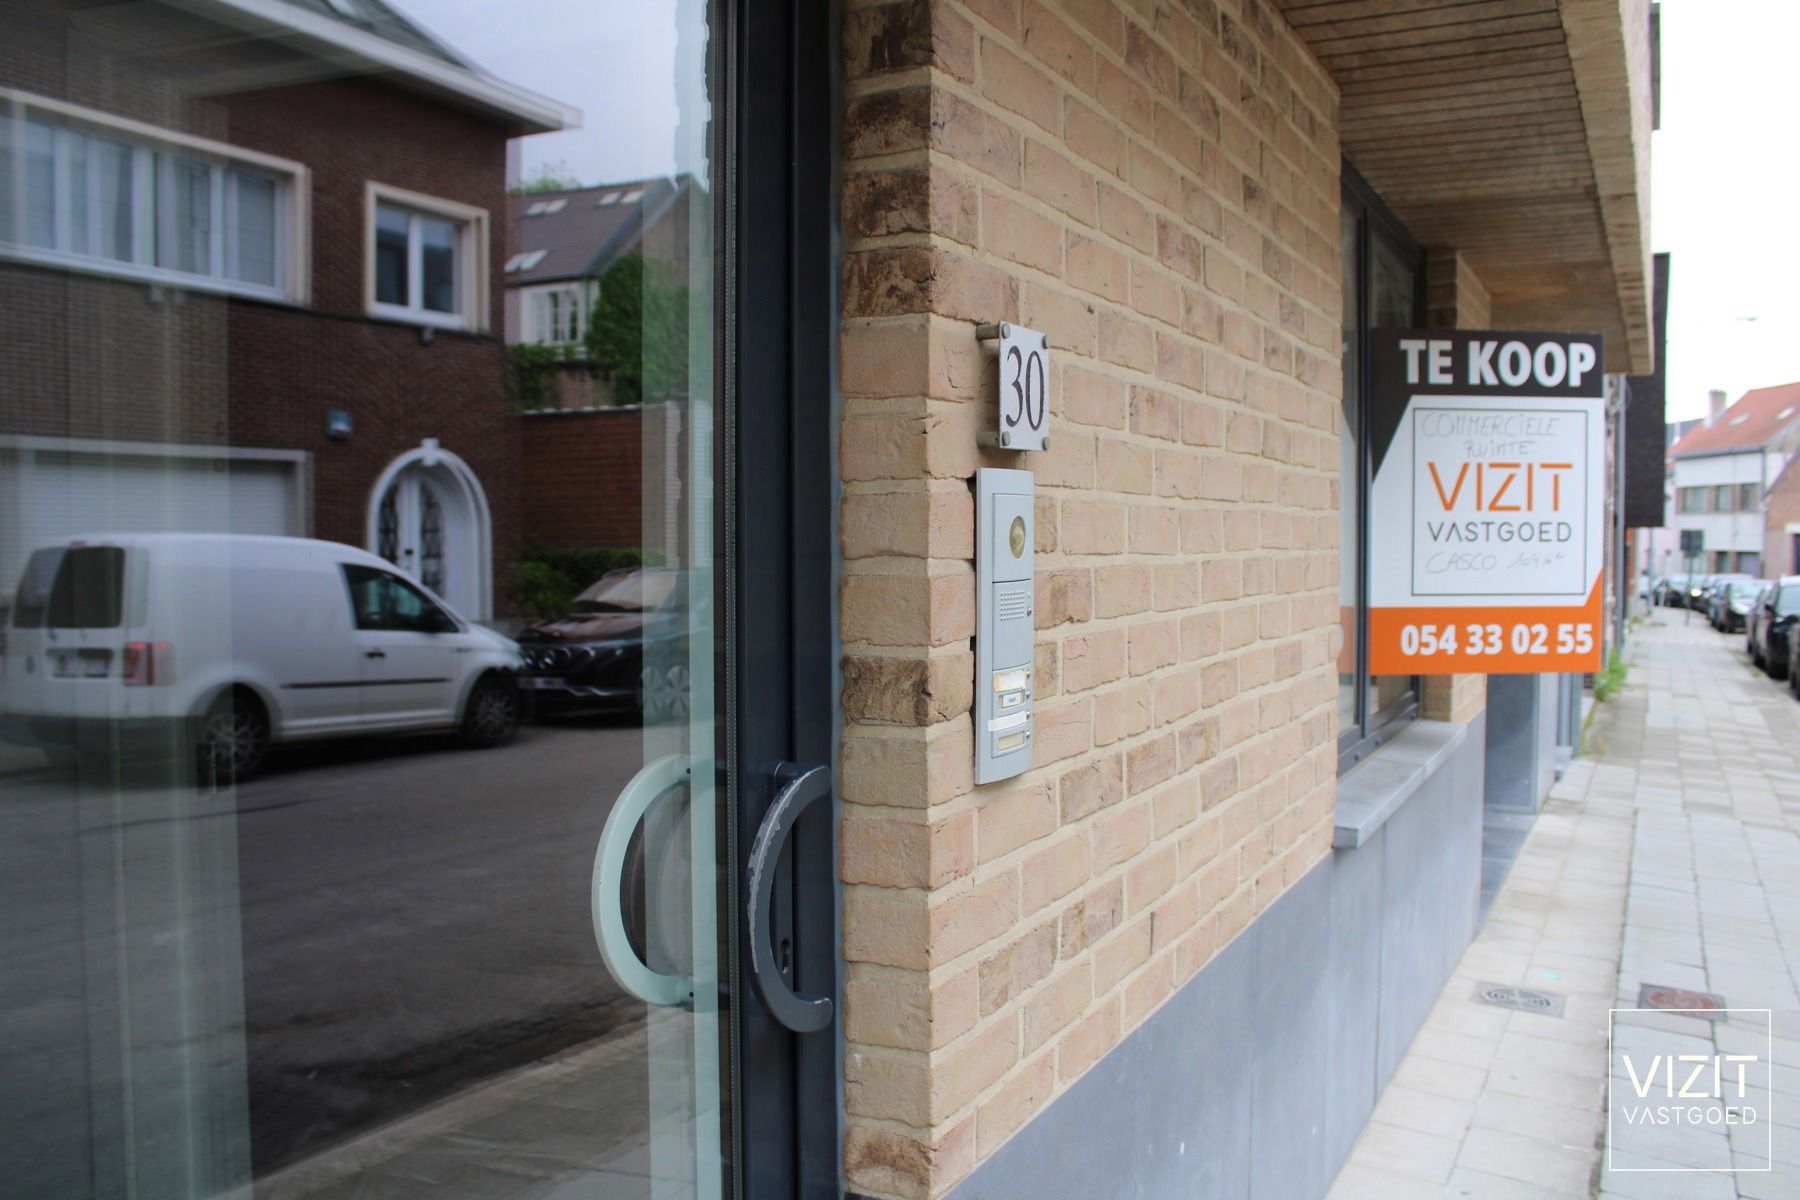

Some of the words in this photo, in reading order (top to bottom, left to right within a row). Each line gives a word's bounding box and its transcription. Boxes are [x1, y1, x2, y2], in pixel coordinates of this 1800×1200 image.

[1400, 339, 1454, 385] TE
[1468, 340, 1597, 387] KOOP
[1005, 345, 1045, 431] 30
[1427, 462, 1574, 512] VIZIT
[1427, 521, 1572, 543] VASTGOED
[1425, 551, 1497, 574] CASCO
[1400, 624, 1458, 656] 054
[1465, 624, 1503, 655] 33
[1511, 624, 1549, 655] 02
[1556, 623, 1594, 654] 55
